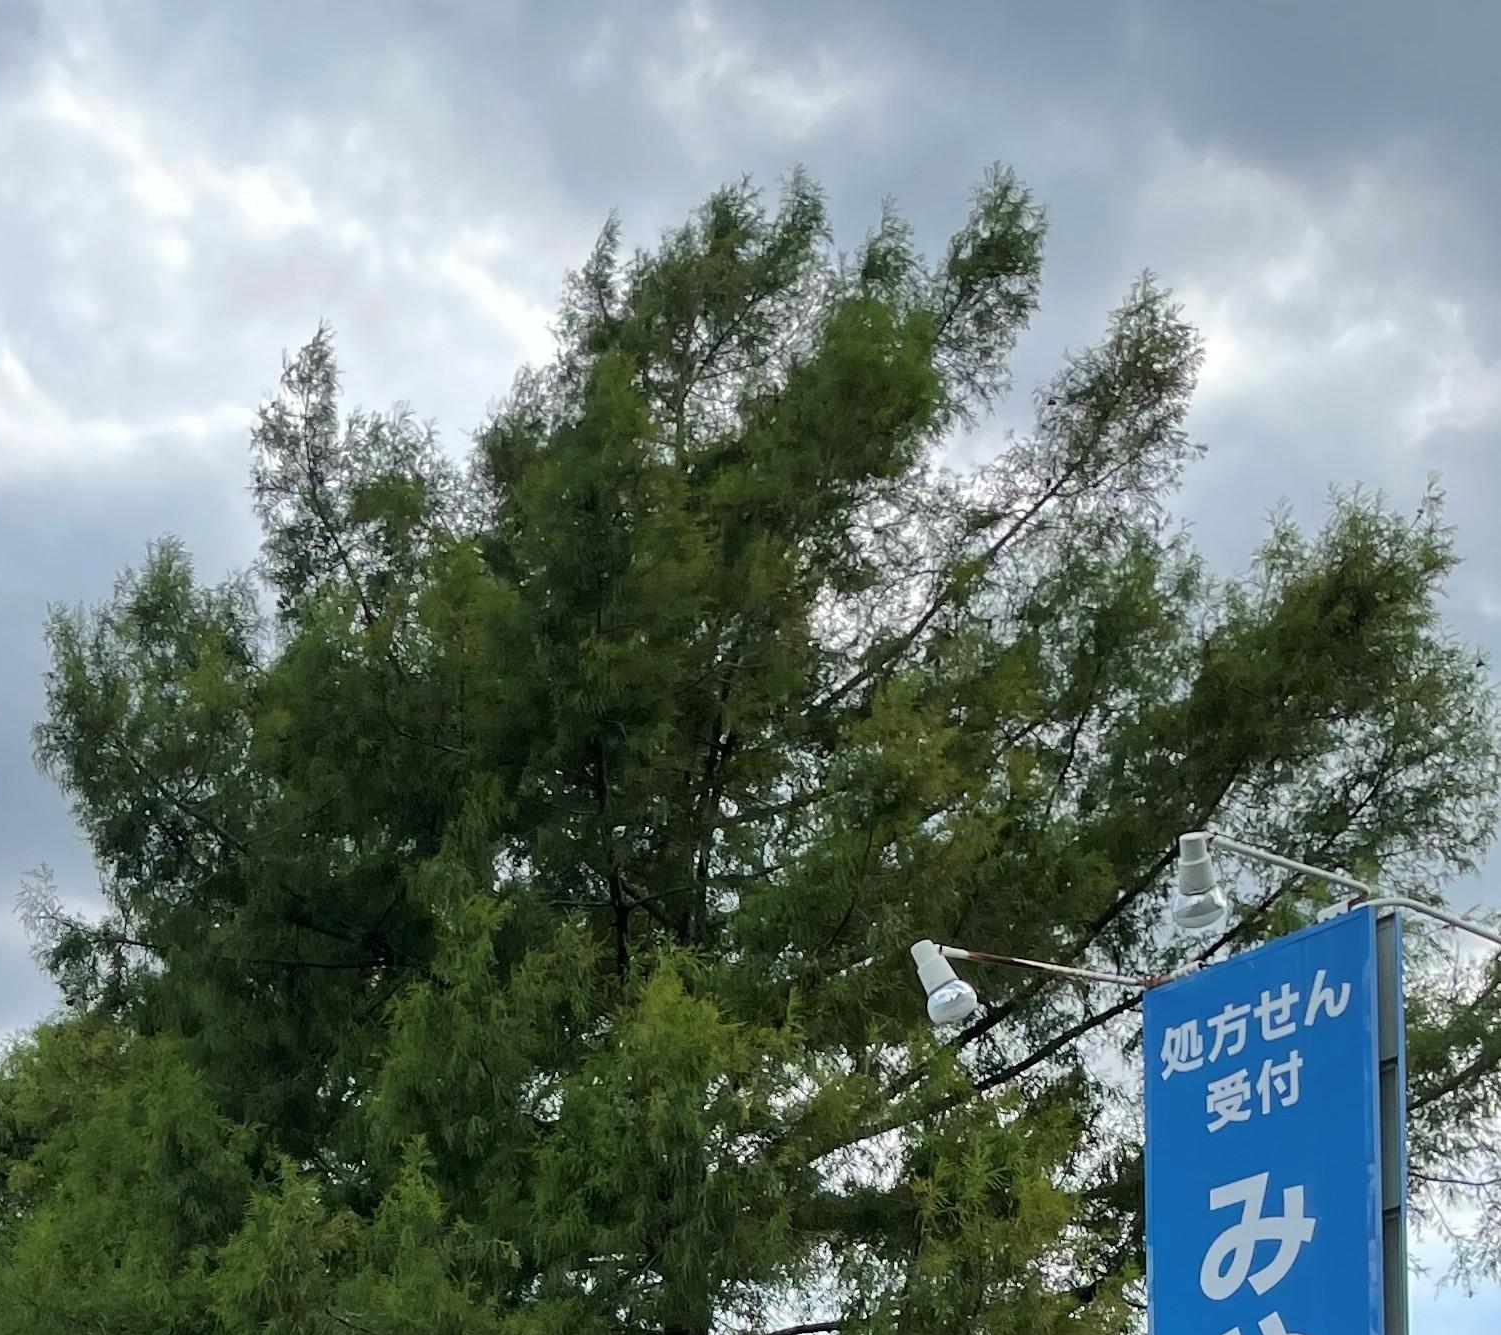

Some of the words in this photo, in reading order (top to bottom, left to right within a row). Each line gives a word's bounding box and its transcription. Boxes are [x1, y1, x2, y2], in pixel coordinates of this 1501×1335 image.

[1160, 969, 1351, 1081] 処方せん
[1206, 1049, 1303, 1133] 受付
